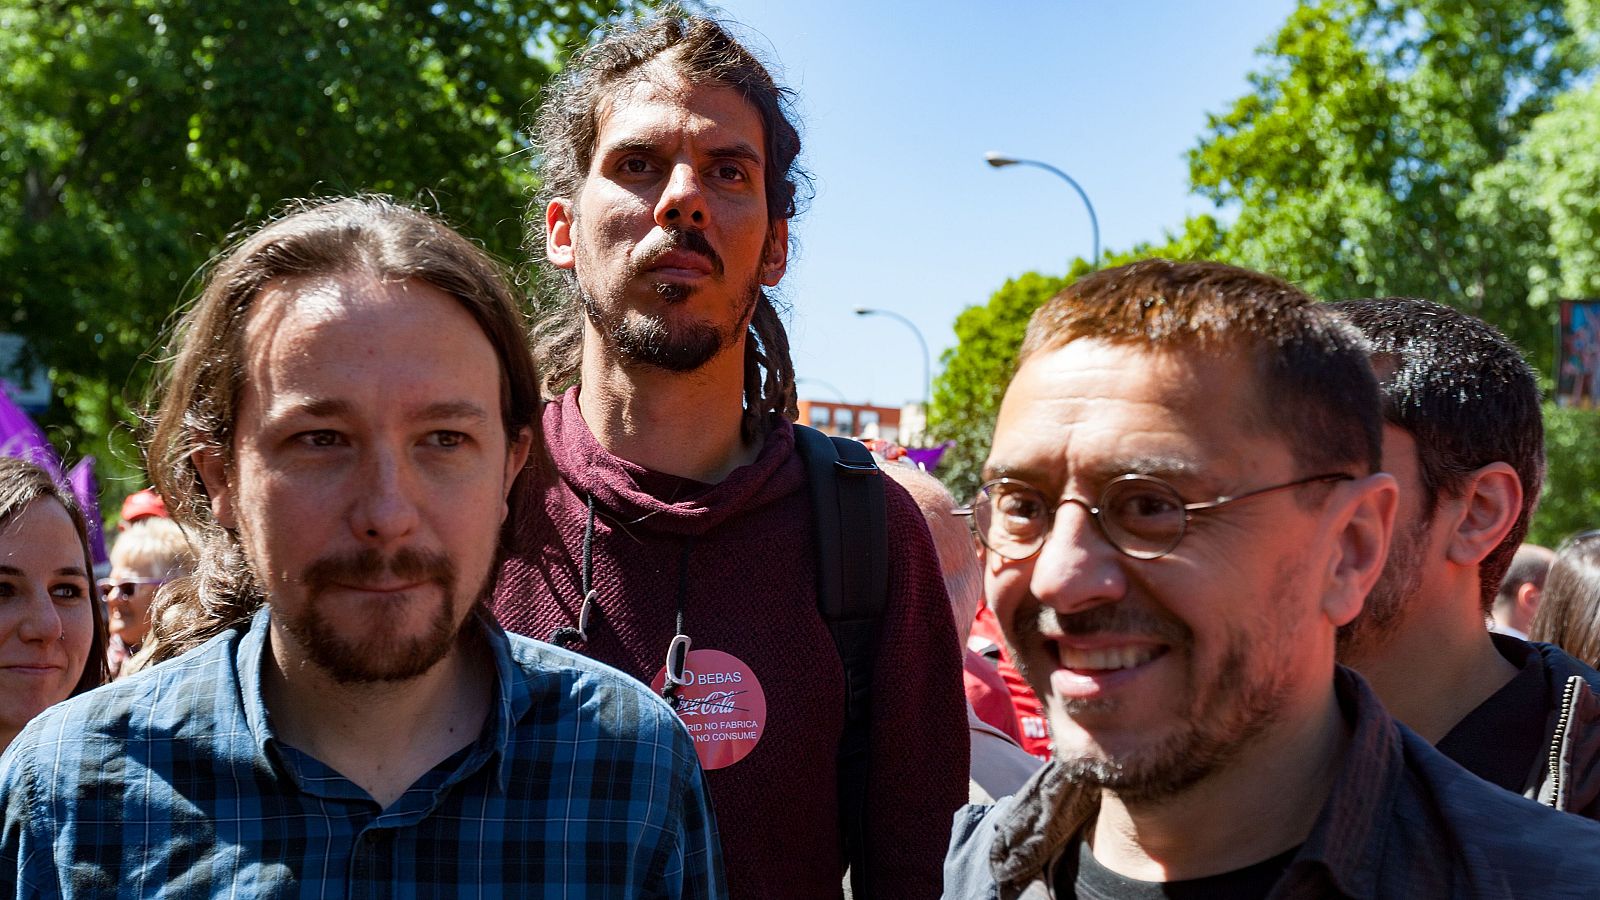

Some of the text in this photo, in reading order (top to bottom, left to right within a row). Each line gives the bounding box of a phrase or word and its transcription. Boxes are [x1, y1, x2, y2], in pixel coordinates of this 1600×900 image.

[698, 671, 742, 685] BEBAS
[687, 720, 758, 732] RID NO FABRICA
[697, 734, 710, 742] NO
[712, 731, 757, 741] CONSUME
